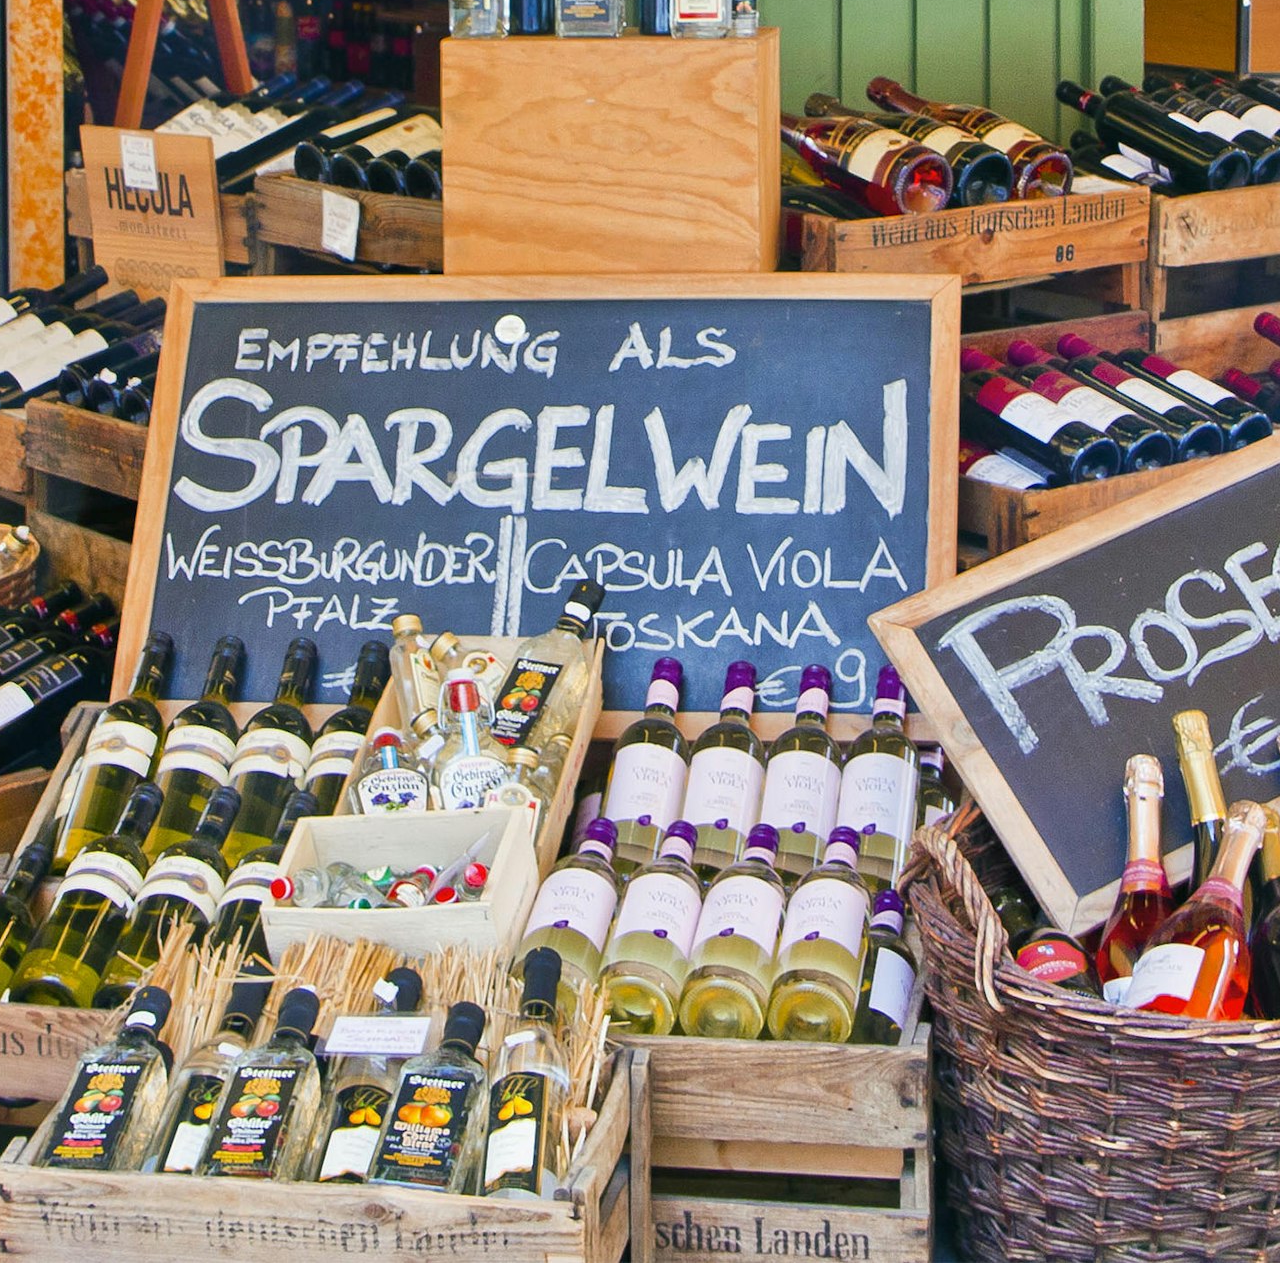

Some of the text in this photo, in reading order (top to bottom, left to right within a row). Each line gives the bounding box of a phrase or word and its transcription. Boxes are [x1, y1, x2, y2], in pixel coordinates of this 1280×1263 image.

[871, 220, 919, 249] Wein
[924, 215, 959, 243] aus
[964, 203, 1055, 237] deutschen
[1062, 195, 1126, 226] Landen
[234, 321, 737, 378] EMPFEHLUNG ALS
[165, 524, 909, 597] WEISSBURGUNDER CAPSULA VIOLA
[238, 585, 842, 653] PFALZ TOSKANA
[655, 1210, 871, 1261] schen Landen
